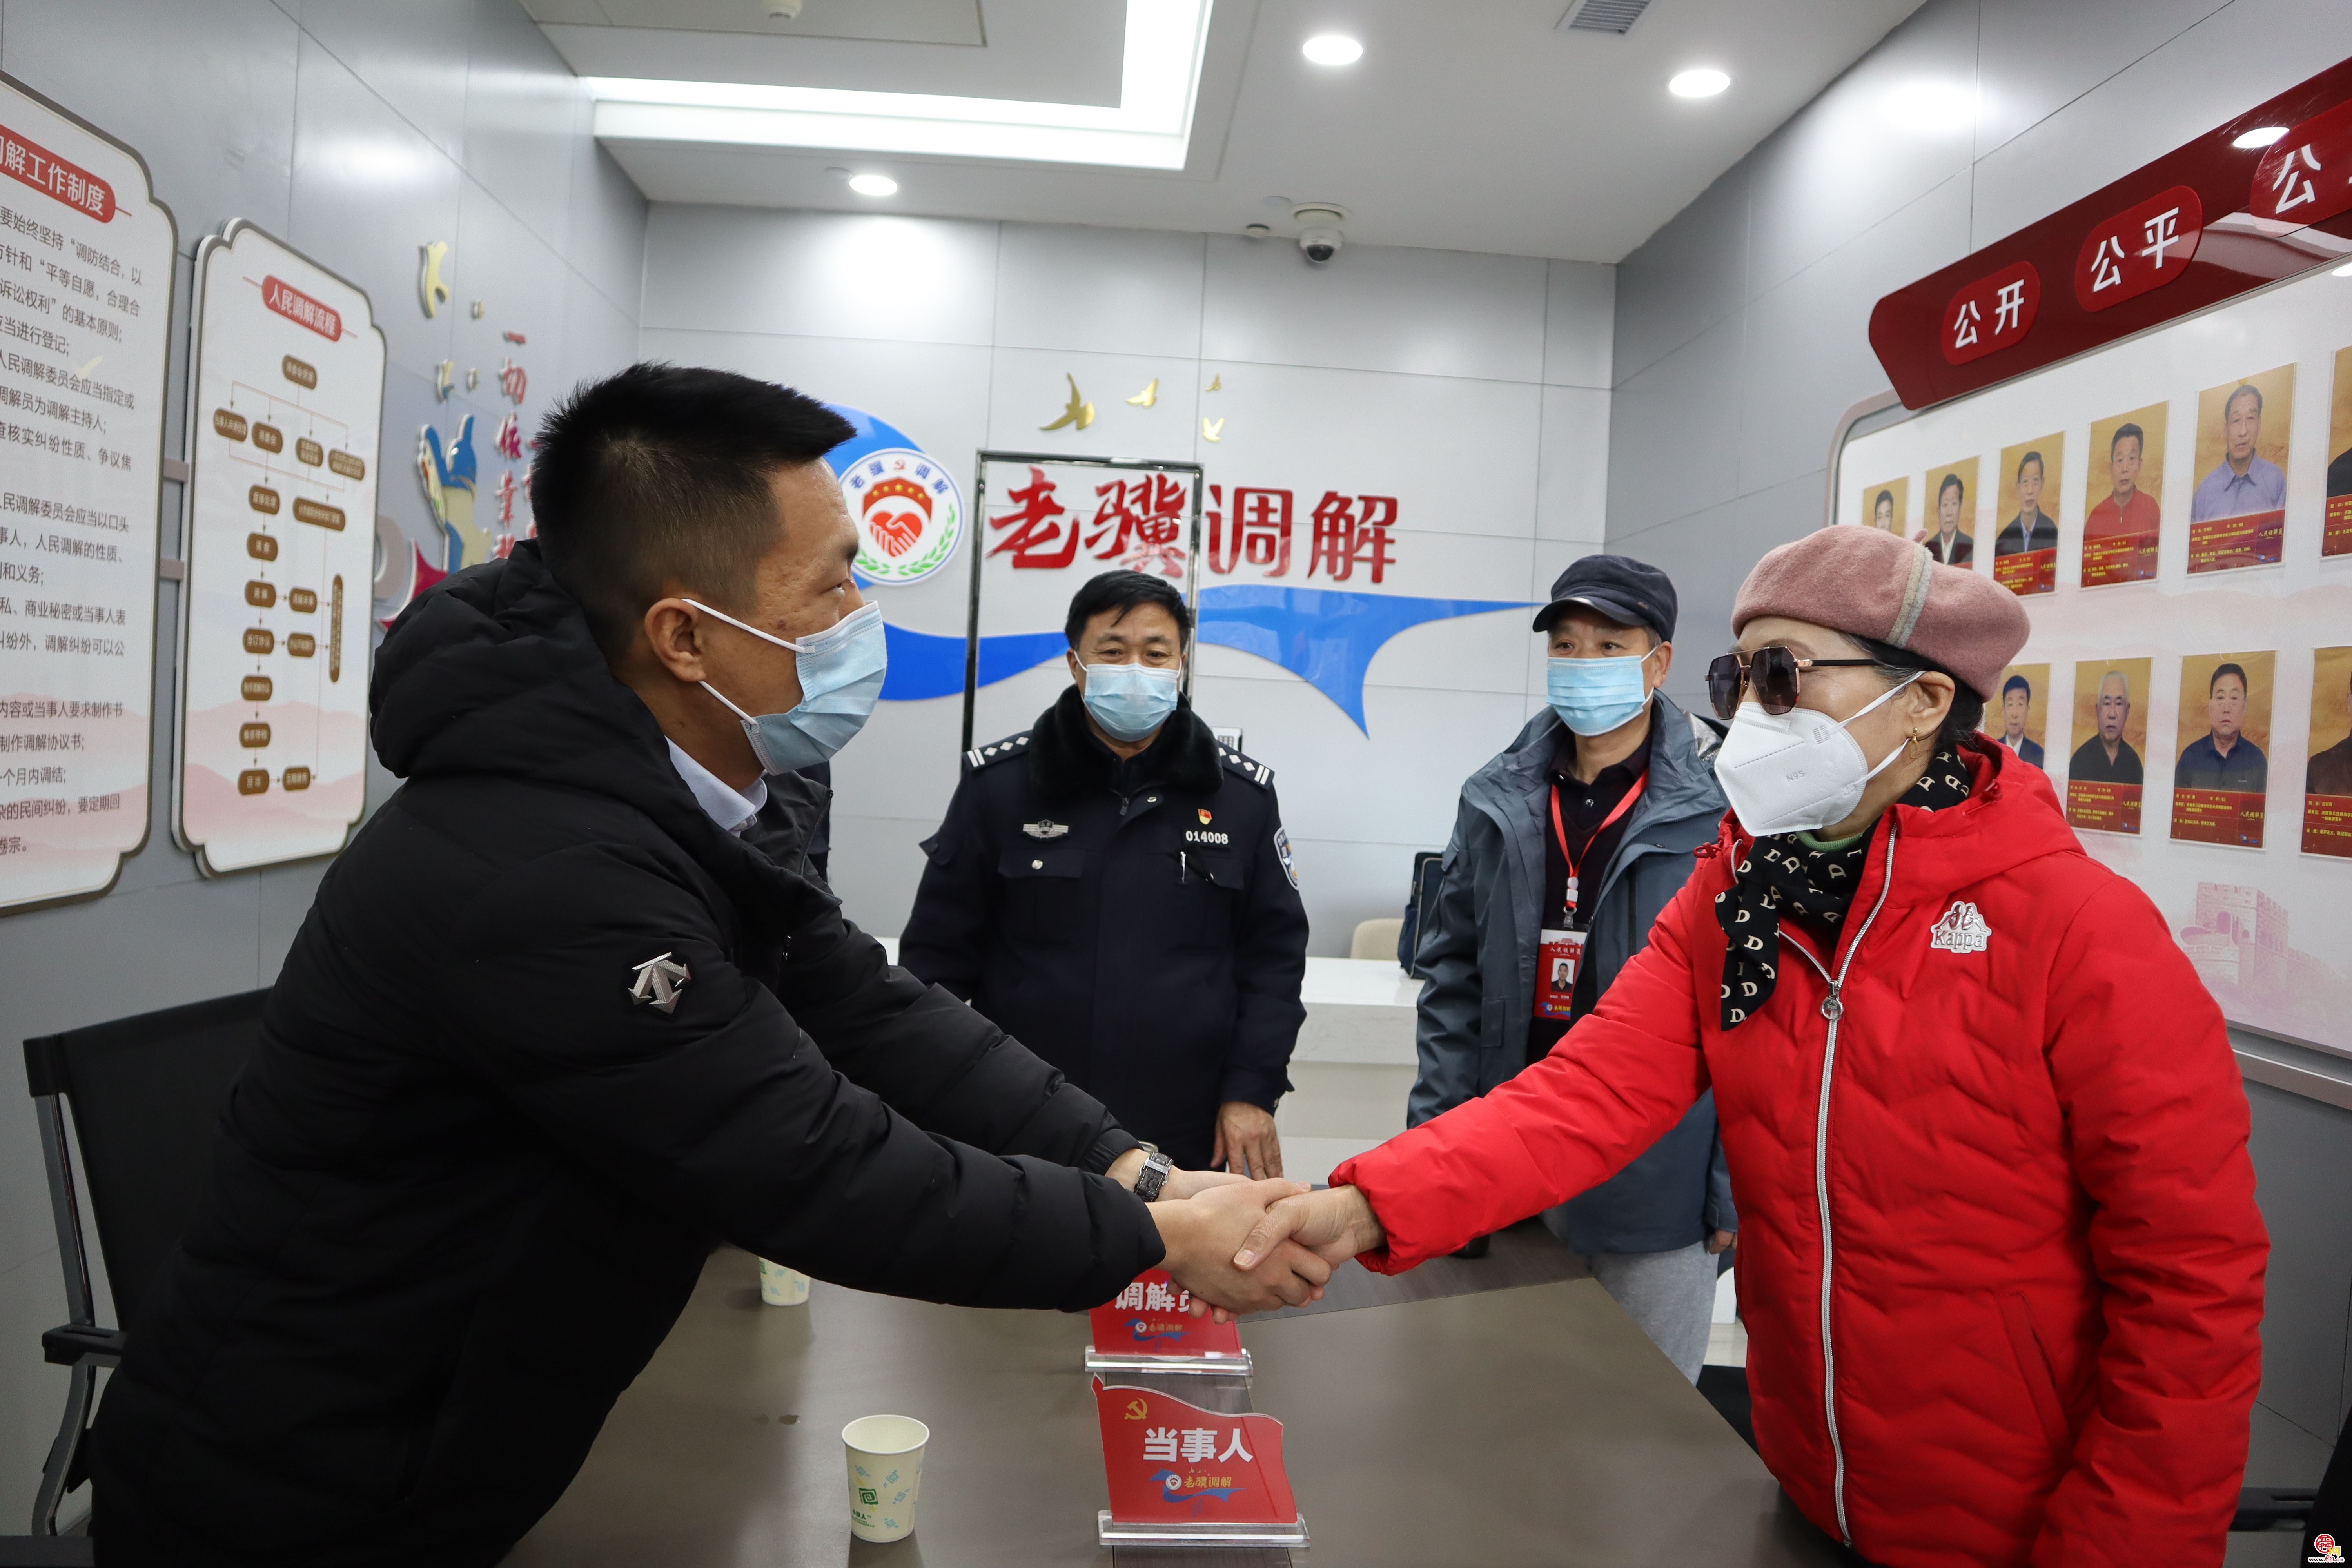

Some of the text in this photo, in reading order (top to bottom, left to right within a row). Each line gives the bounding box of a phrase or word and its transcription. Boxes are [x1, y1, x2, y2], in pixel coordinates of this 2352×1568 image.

[2273, 144, 2352, 214] 公
[2091, 207, 2180, 293] 公平
[0, 244, 140, 317] 针和“平等自愿，合理合
[1954, 279, 2025, 349] 公开
[0, 315, 69, 357] 当进行登记；
[0, 492, 129, 533] 民调解委员会应当以口头
[985, 465, 1398, 584] 老骥调解
[0, 561, 44, 586] 和义务；
[0, 766, 66, 787] 个月内调结；
[1786, 770, 1805, 782] N95
[1185, 831, 1229, 844] 014008
[1935, 930, 1983, 950] Kappa
[1143, 1427, 1254, 1463] 当事人
[1184, 1475, 1232, 1488] 老骥调解
